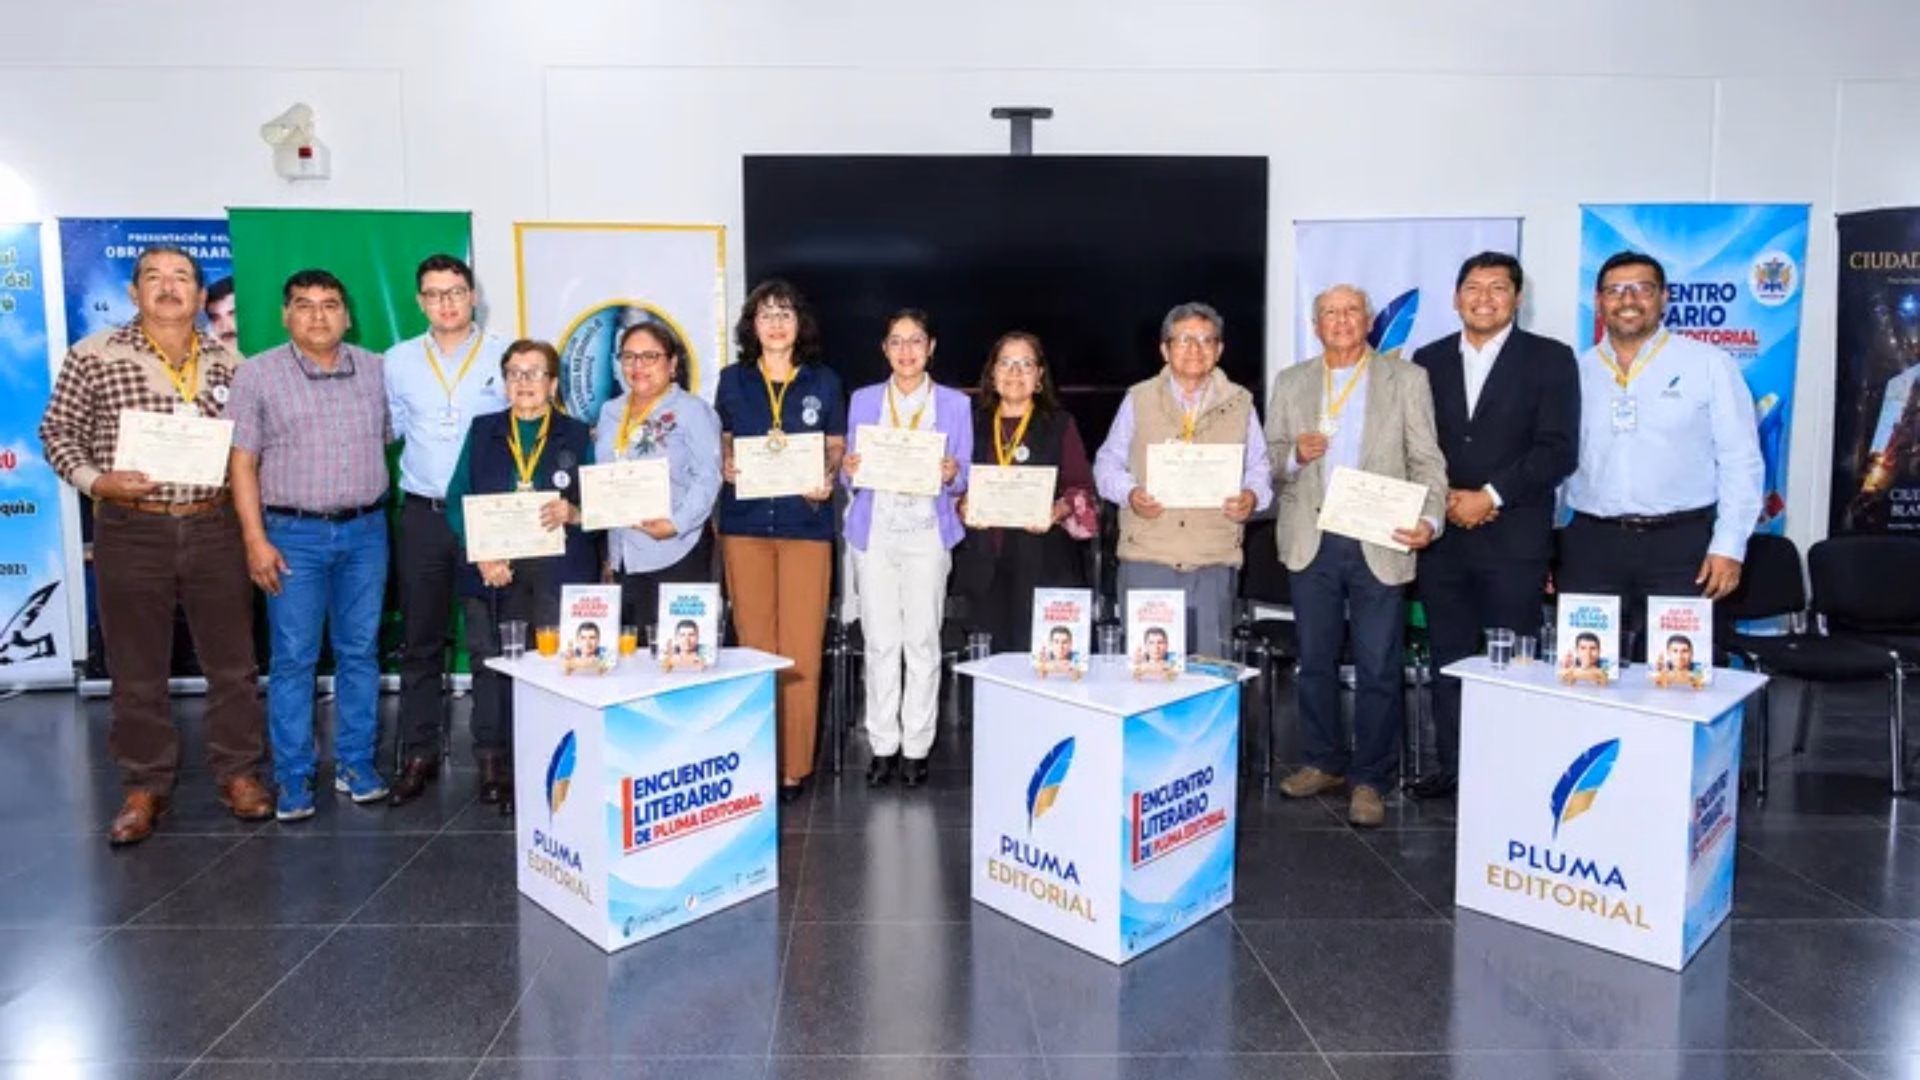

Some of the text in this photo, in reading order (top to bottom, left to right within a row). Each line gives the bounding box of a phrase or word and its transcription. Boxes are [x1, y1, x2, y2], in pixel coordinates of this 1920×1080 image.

[1664, 304, 1726, 327] ARIO
[1667, 283, 1737, 303] ENTRO
[1677, 328, 1758, 346] DITORIAL
[634, 752, 739, 799] ENCUENTRO
[1141, 765, 1214, 815] ENCUENTRO
[634, 778, 732, 827] LITERARIO
[635, 792, 762, 845] DE PLUMA EDITORIAL
[1141, 791, 1208, 841] LITERARIO
[533, 828, 583, 873] PLUMA
[1140, 806, 1227, 861] DE PLUMA EDITORIAL
[527, 848, 593, 905] EDITORIAL
[1001, 834, 1081, 886] PLUMA
[1508, 839, 1628, 891] PLUMA
[988, 857, 1097, 922] EDITORIAL
[1486, 863, 1652, 931] EDITORIAL
